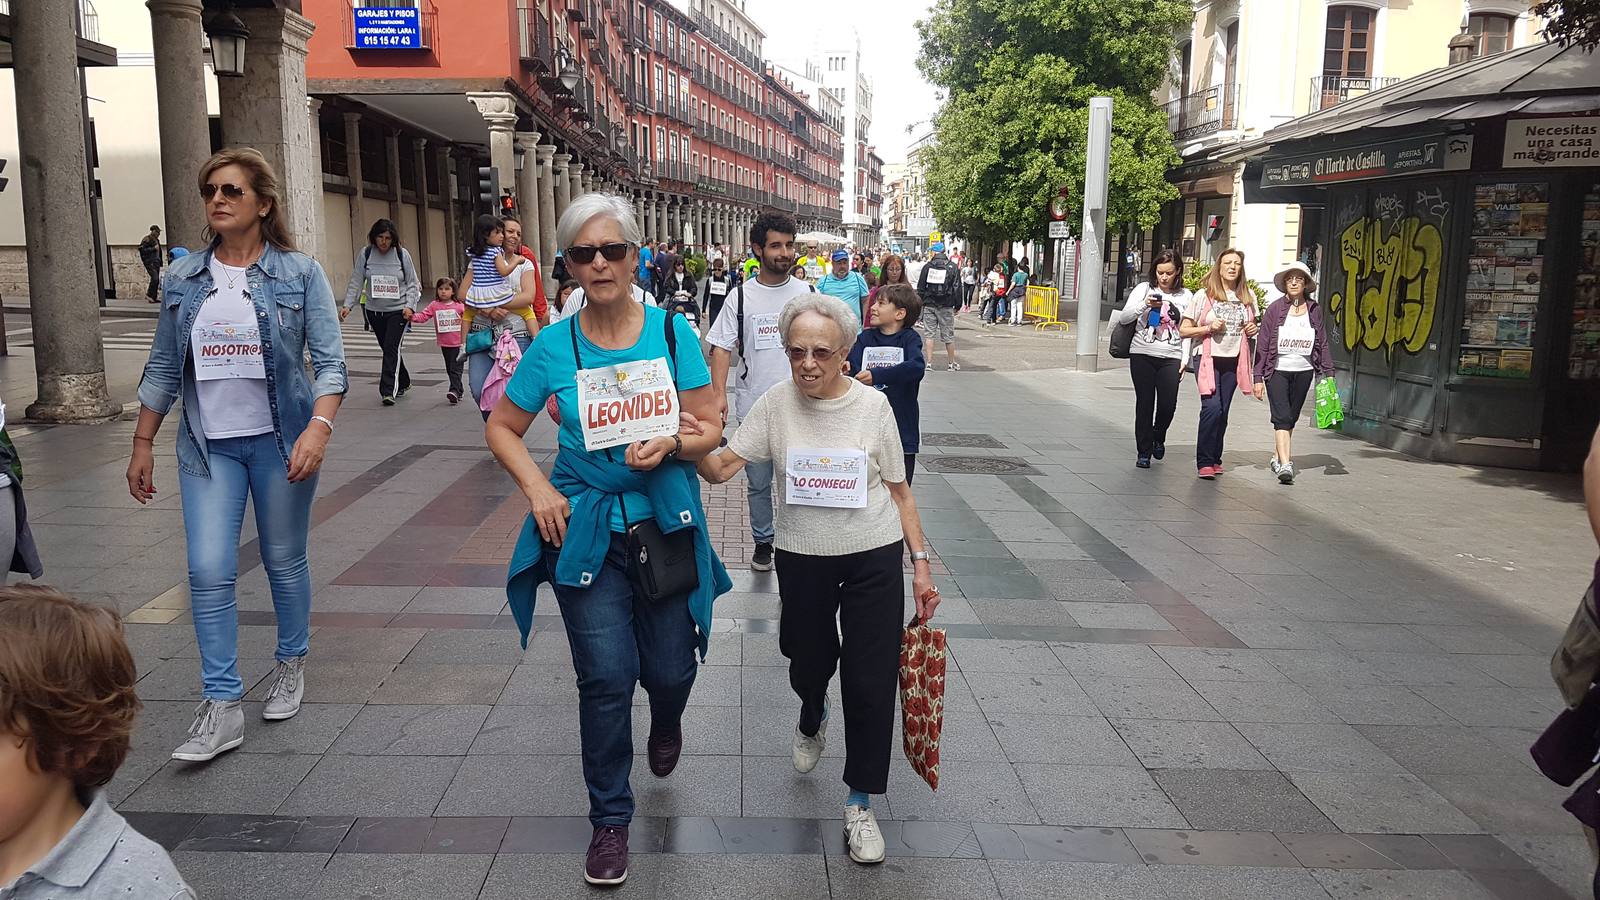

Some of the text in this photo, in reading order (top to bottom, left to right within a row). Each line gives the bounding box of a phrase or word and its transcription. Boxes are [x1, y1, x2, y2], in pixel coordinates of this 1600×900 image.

[364, 36, 410, 45] 615 15 47 43
[1526, 124, 1598, 136] Necesitas
[1528, 138, 1592, 148] una casa
[1513, 149, 1541, 160] má
[1315, 150, 1386, 176] El Norte de Castilla
[758, 326, 779, 334] NOSO
[588, 388, 672, 429] LEONIDES
[794, 477, 858, 489] LO CONSEGUÍ
